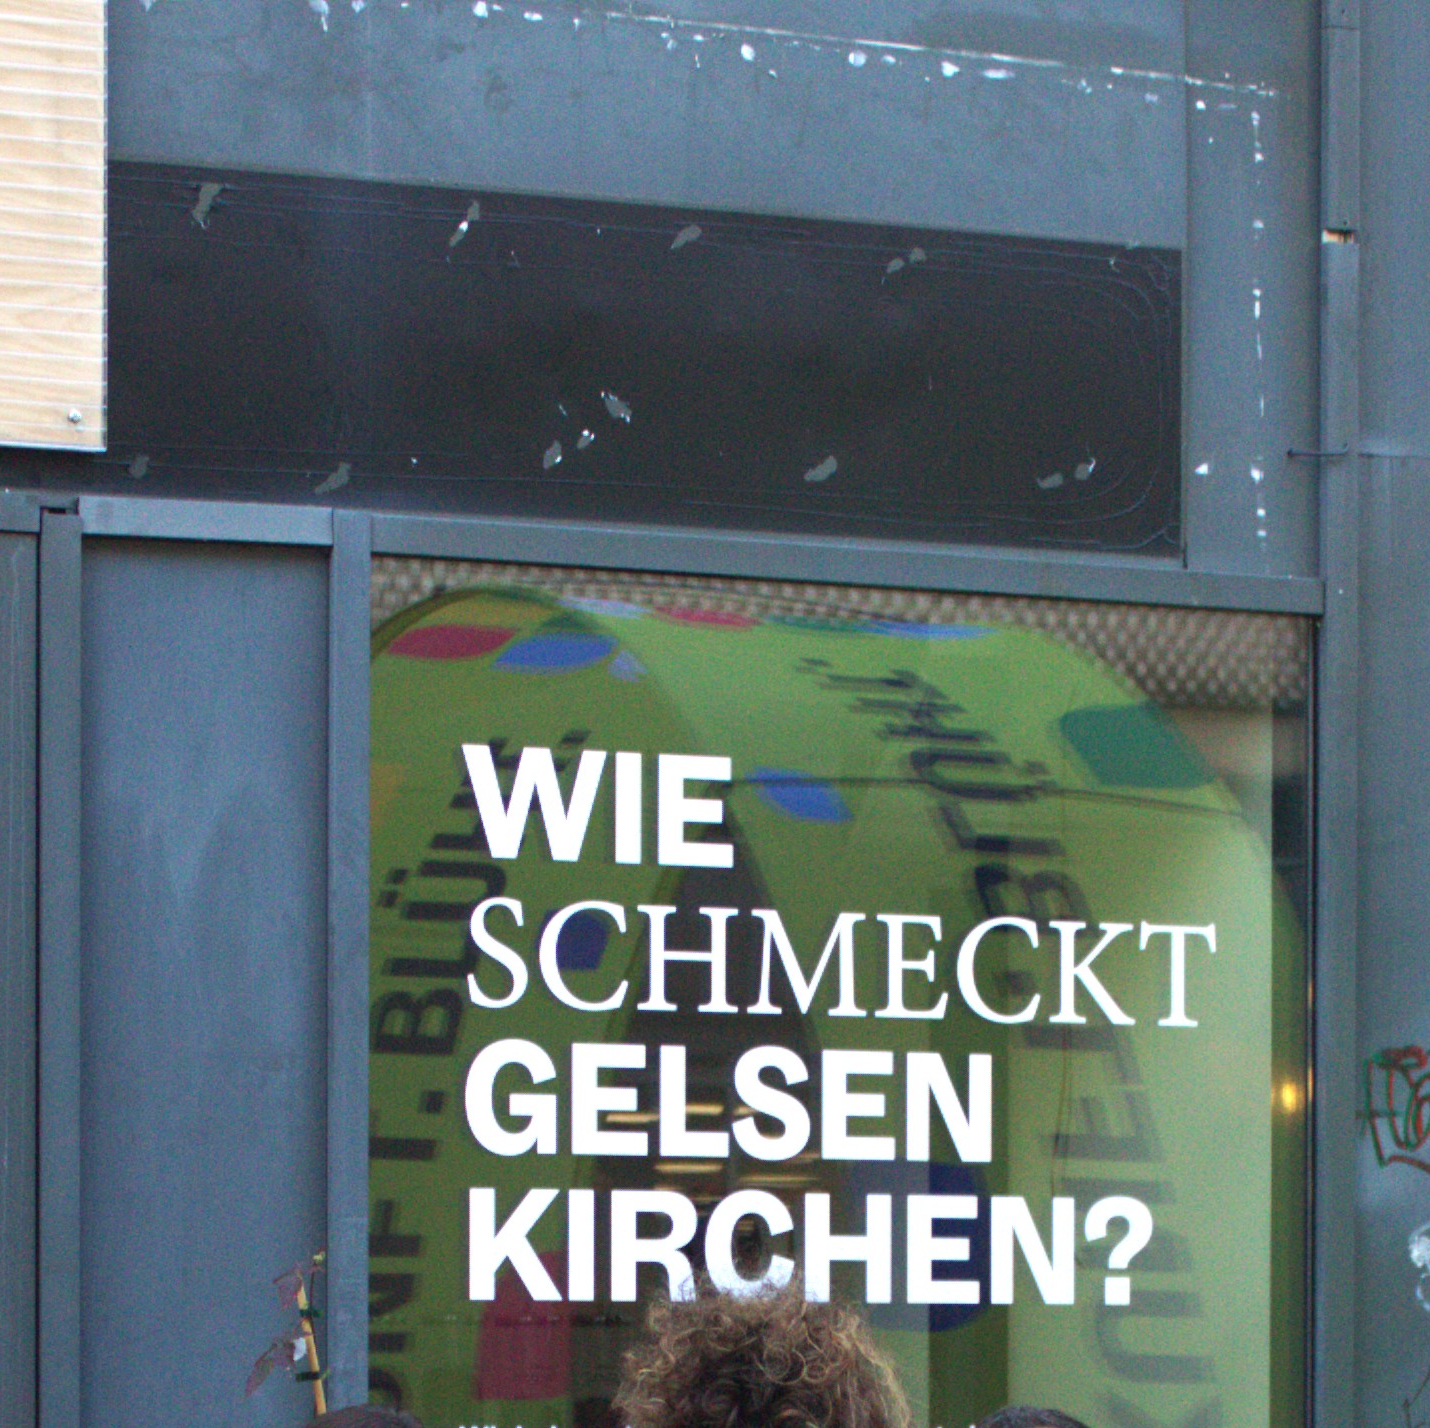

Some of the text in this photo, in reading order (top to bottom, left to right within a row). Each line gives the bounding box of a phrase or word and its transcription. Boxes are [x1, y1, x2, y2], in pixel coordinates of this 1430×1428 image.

[461, 743, 736, 869] WIE
[467, 897, 1218, 1029] SCHMECKT
[465, 1039, 994, 1163] GELSEN
[469, 1187, 1154, 1306] KIRCHEN?
